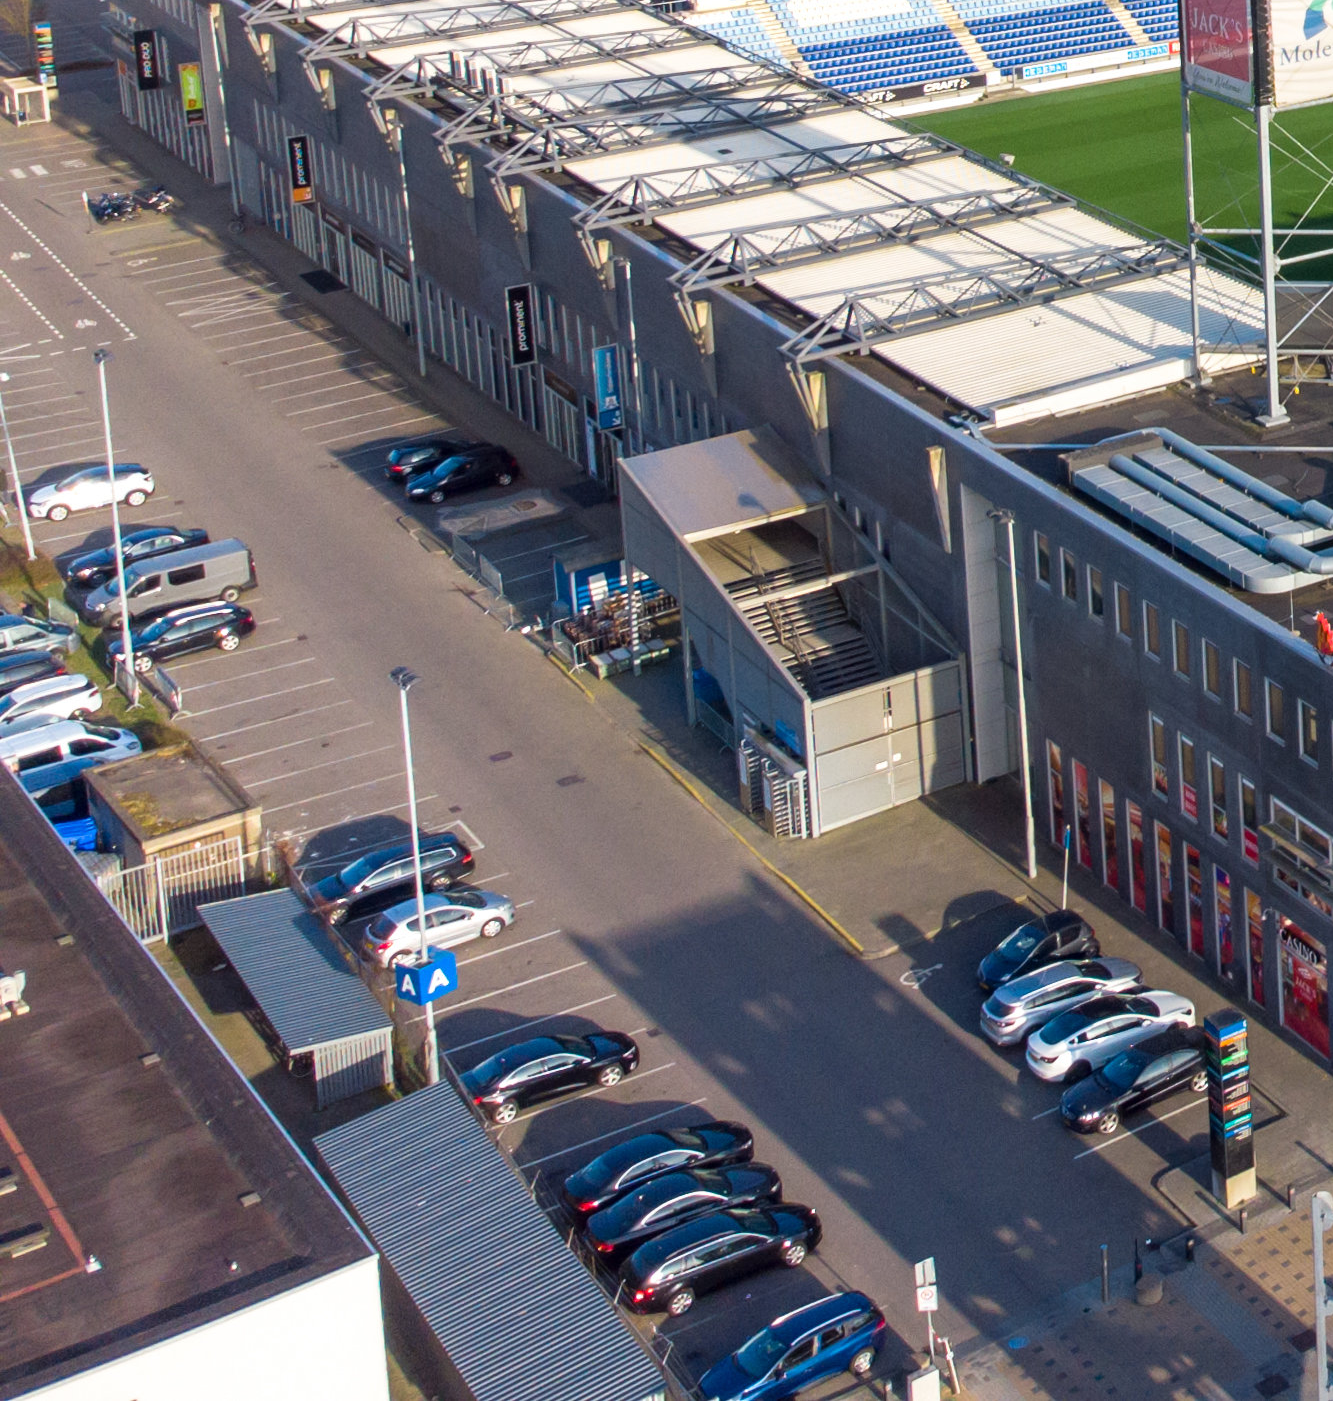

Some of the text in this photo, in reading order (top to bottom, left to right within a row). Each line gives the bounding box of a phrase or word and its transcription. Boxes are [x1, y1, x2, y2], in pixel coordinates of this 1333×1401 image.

[1191, 7, 1244, 44] JACK'S
[924, 78, 960, 93] CRAFT
[292, 141, 307, 186] prominent
[513, 299, 529, 351] prominent
[1278, 928, 1320, 966] CASINO
[401, 973, 416, 996] A
[428, 967, 450, 994] A
